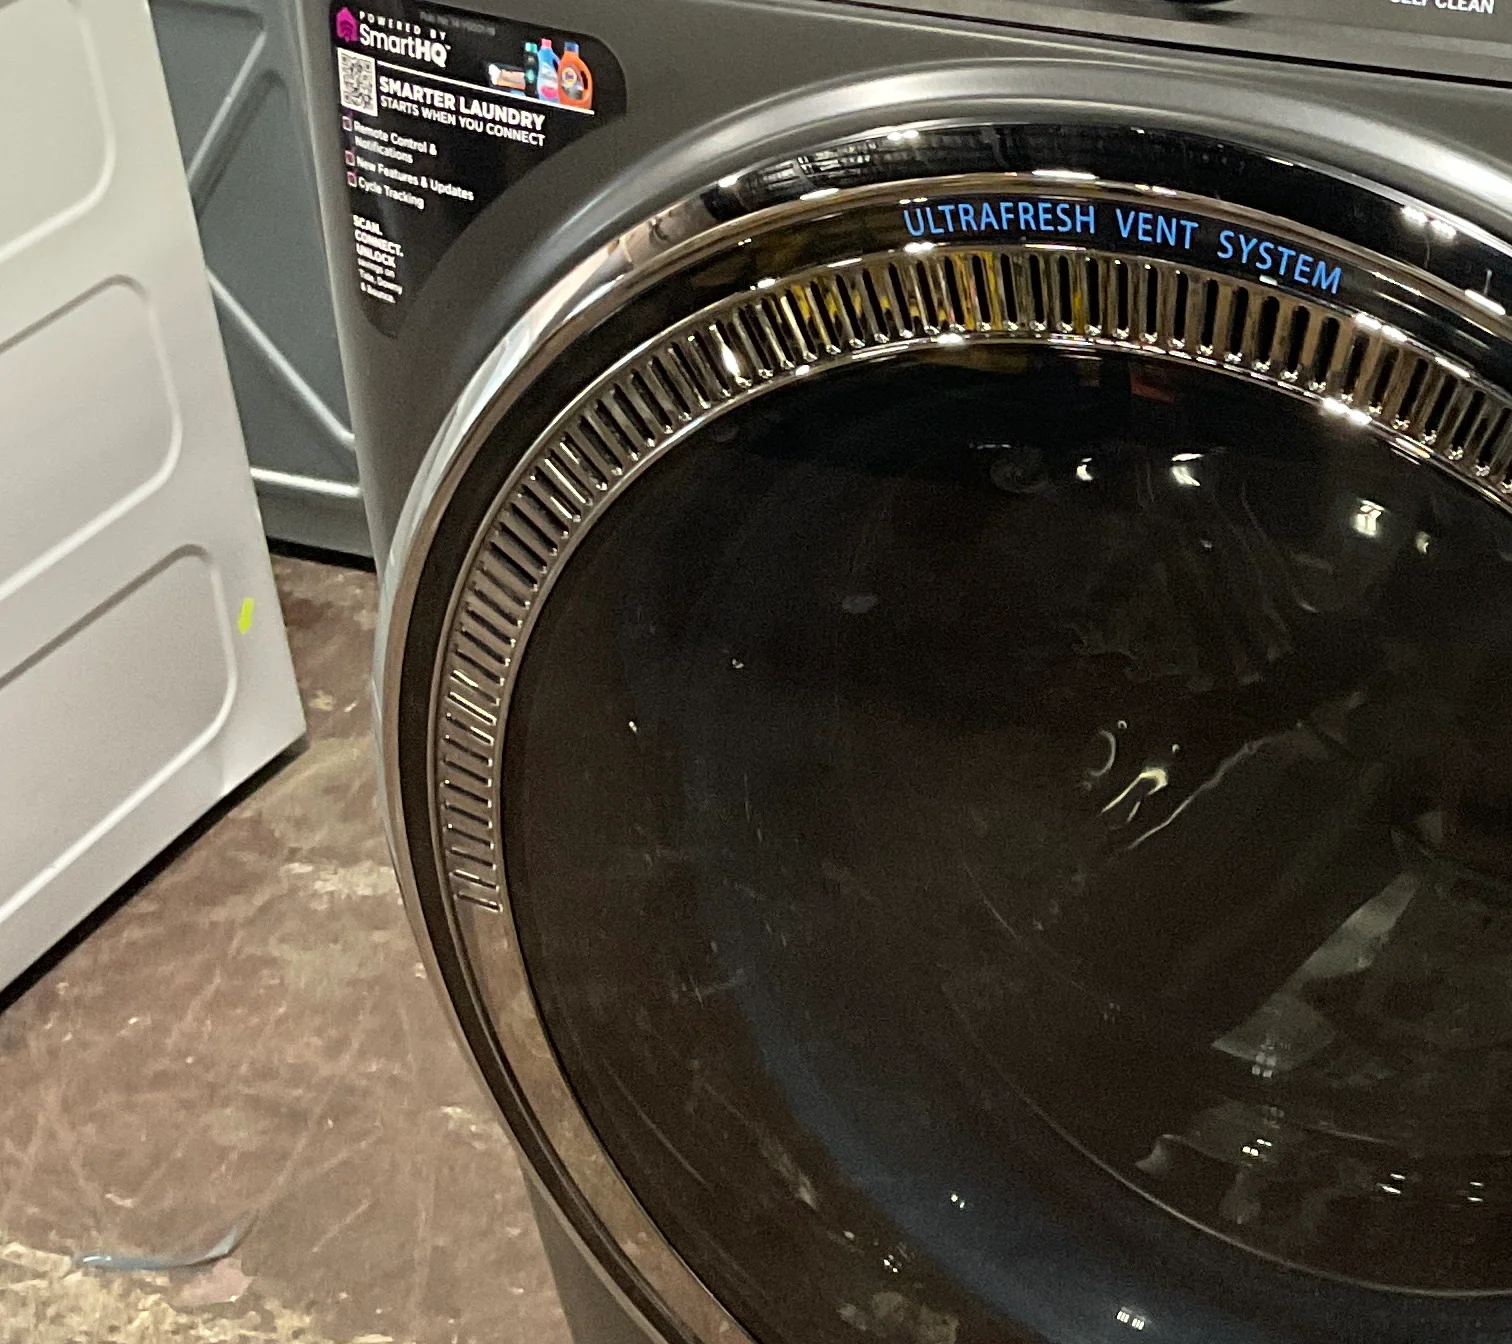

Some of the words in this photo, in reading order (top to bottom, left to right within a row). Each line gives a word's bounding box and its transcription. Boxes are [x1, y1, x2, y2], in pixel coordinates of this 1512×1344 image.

[359, 10, 422, 35] POWERED
[429, 27, 447, 41] BY
[359, 22, 449, 68] SmartHQ
[379, 75, 456, 111] SMARTER
[459, 94, 546, 131] LAUNDRY
[380, 94, 420, 117] STARTS
[420, 106, 457, 126] WHEN
[458, 115, 484, 133] YOU
[485, 122, 546, 147] CONNECT
[353, 120, 389, 143] Remote
[390, 132, 428, 153] Control
[429, 143, 438, 156] &
[354, 135, 414, 164] Notifications
[356, 155, 377, 173] New
[377, 163, 419, 186] Features
[420, 176, 429, 188] &
[429, 178, 475, 202] Updates
[358, 176, 383, 196] Cycle
[383, 184, 425, 210] Tracking
[354, 228, 405, 258] CONNECT.
[355, 242, 397, 269] UNLOCK
[903, 201, 1096, 237] ULTRAFRESH
[1115, 207, 1200, 250] VENT
[1216, 229, 1343, 295] SYSTEM
